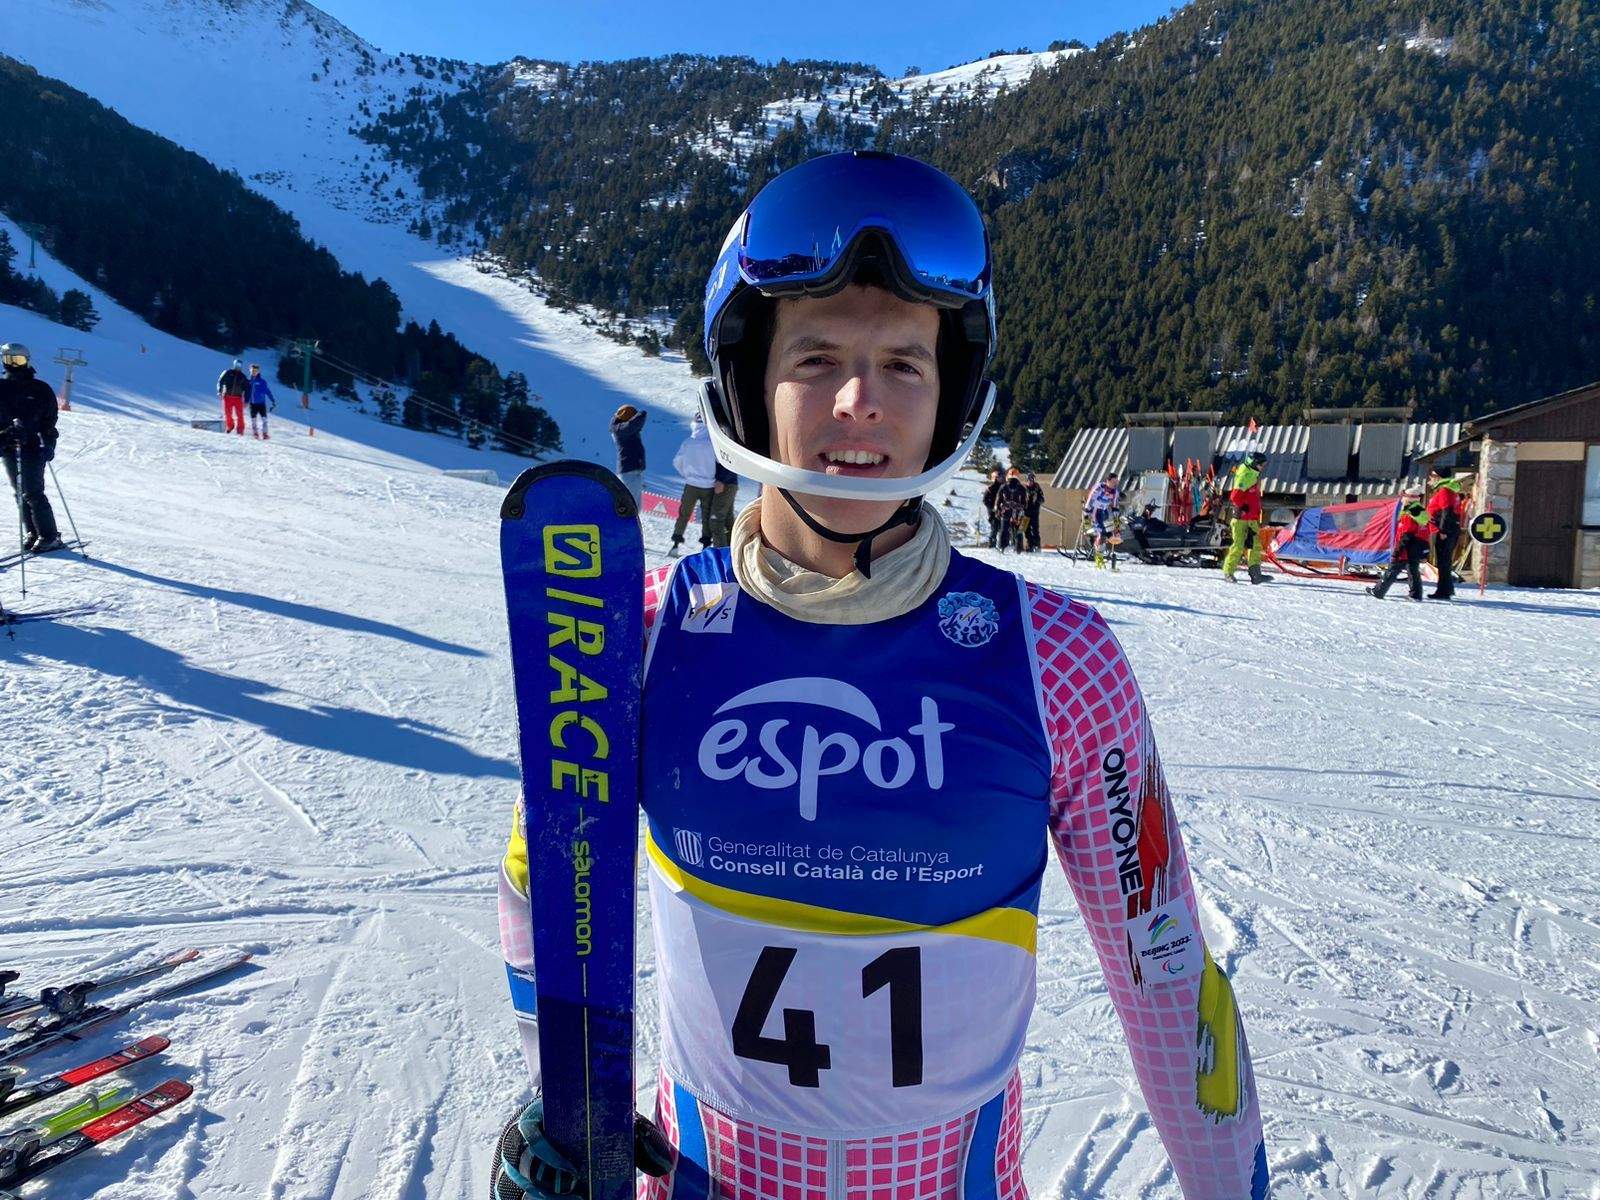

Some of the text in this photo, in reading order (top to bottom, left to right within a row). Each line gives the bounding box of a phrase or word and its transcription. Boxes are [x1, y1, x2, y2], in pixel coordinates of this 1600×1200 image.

[698, 696, 955, 822] espot
[708, 836, 950, 866] Generalitat de Catalunya
[709, 856, 786, 877] Consell
[793, 862, 864, 881] Català
[871, 863, 899, 882] de
[574, 840, 592, 956] salomon
[1141, 944, 1170, 957] BEIJING
[1170, 936, 1191, 948] 2022
[731, 945, 924, 1088] 41
